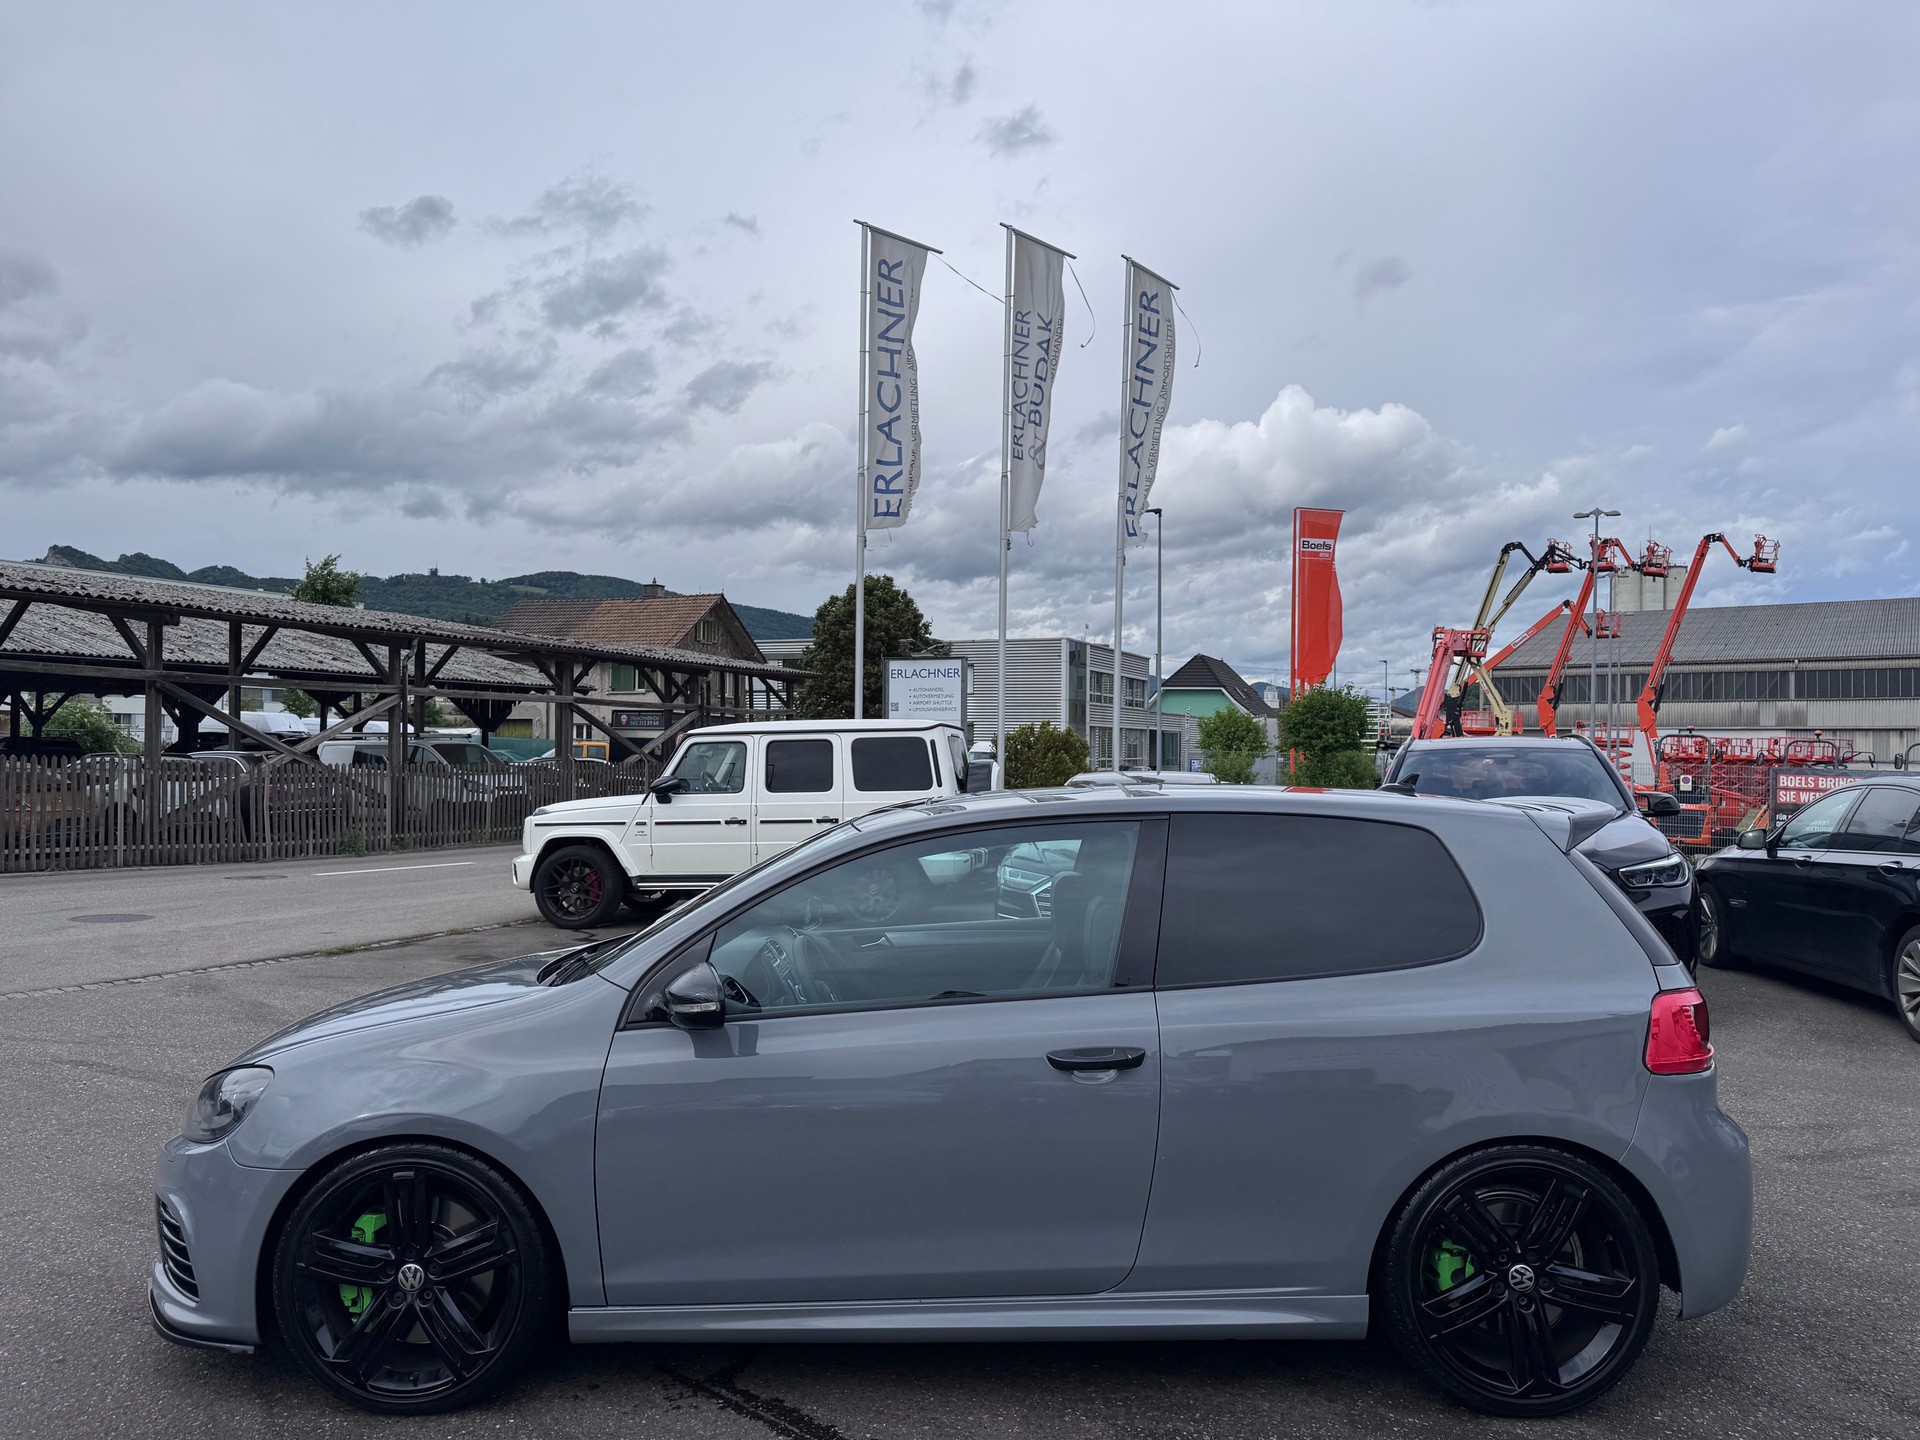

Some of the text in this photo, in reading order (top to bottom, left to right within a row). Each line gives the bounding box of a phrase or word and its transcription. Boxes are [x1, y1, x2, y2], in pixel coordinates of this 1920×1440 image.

[873, 259, 906, 518] ERLACHNER
[909, 378, 918, 442] VERMIETUNG
[1012, 310, 1031, 461] ERLACHNER
[1028, 311, 1053, 428] BUDAK
[1125, 290, 1160, 537] ERLACHNER
[1146, 406, 1165, 469] VERMIETUNG
[1159, 317, 1173, 400] AIRPORTSHUTTLE
[1302, 540, 1332, 550] Boels
[891, 668, 960, 679] ERLACHNER
[1779, 776, 1814, 787] BOELS
[1779, 790, 1797, 802] SIE
